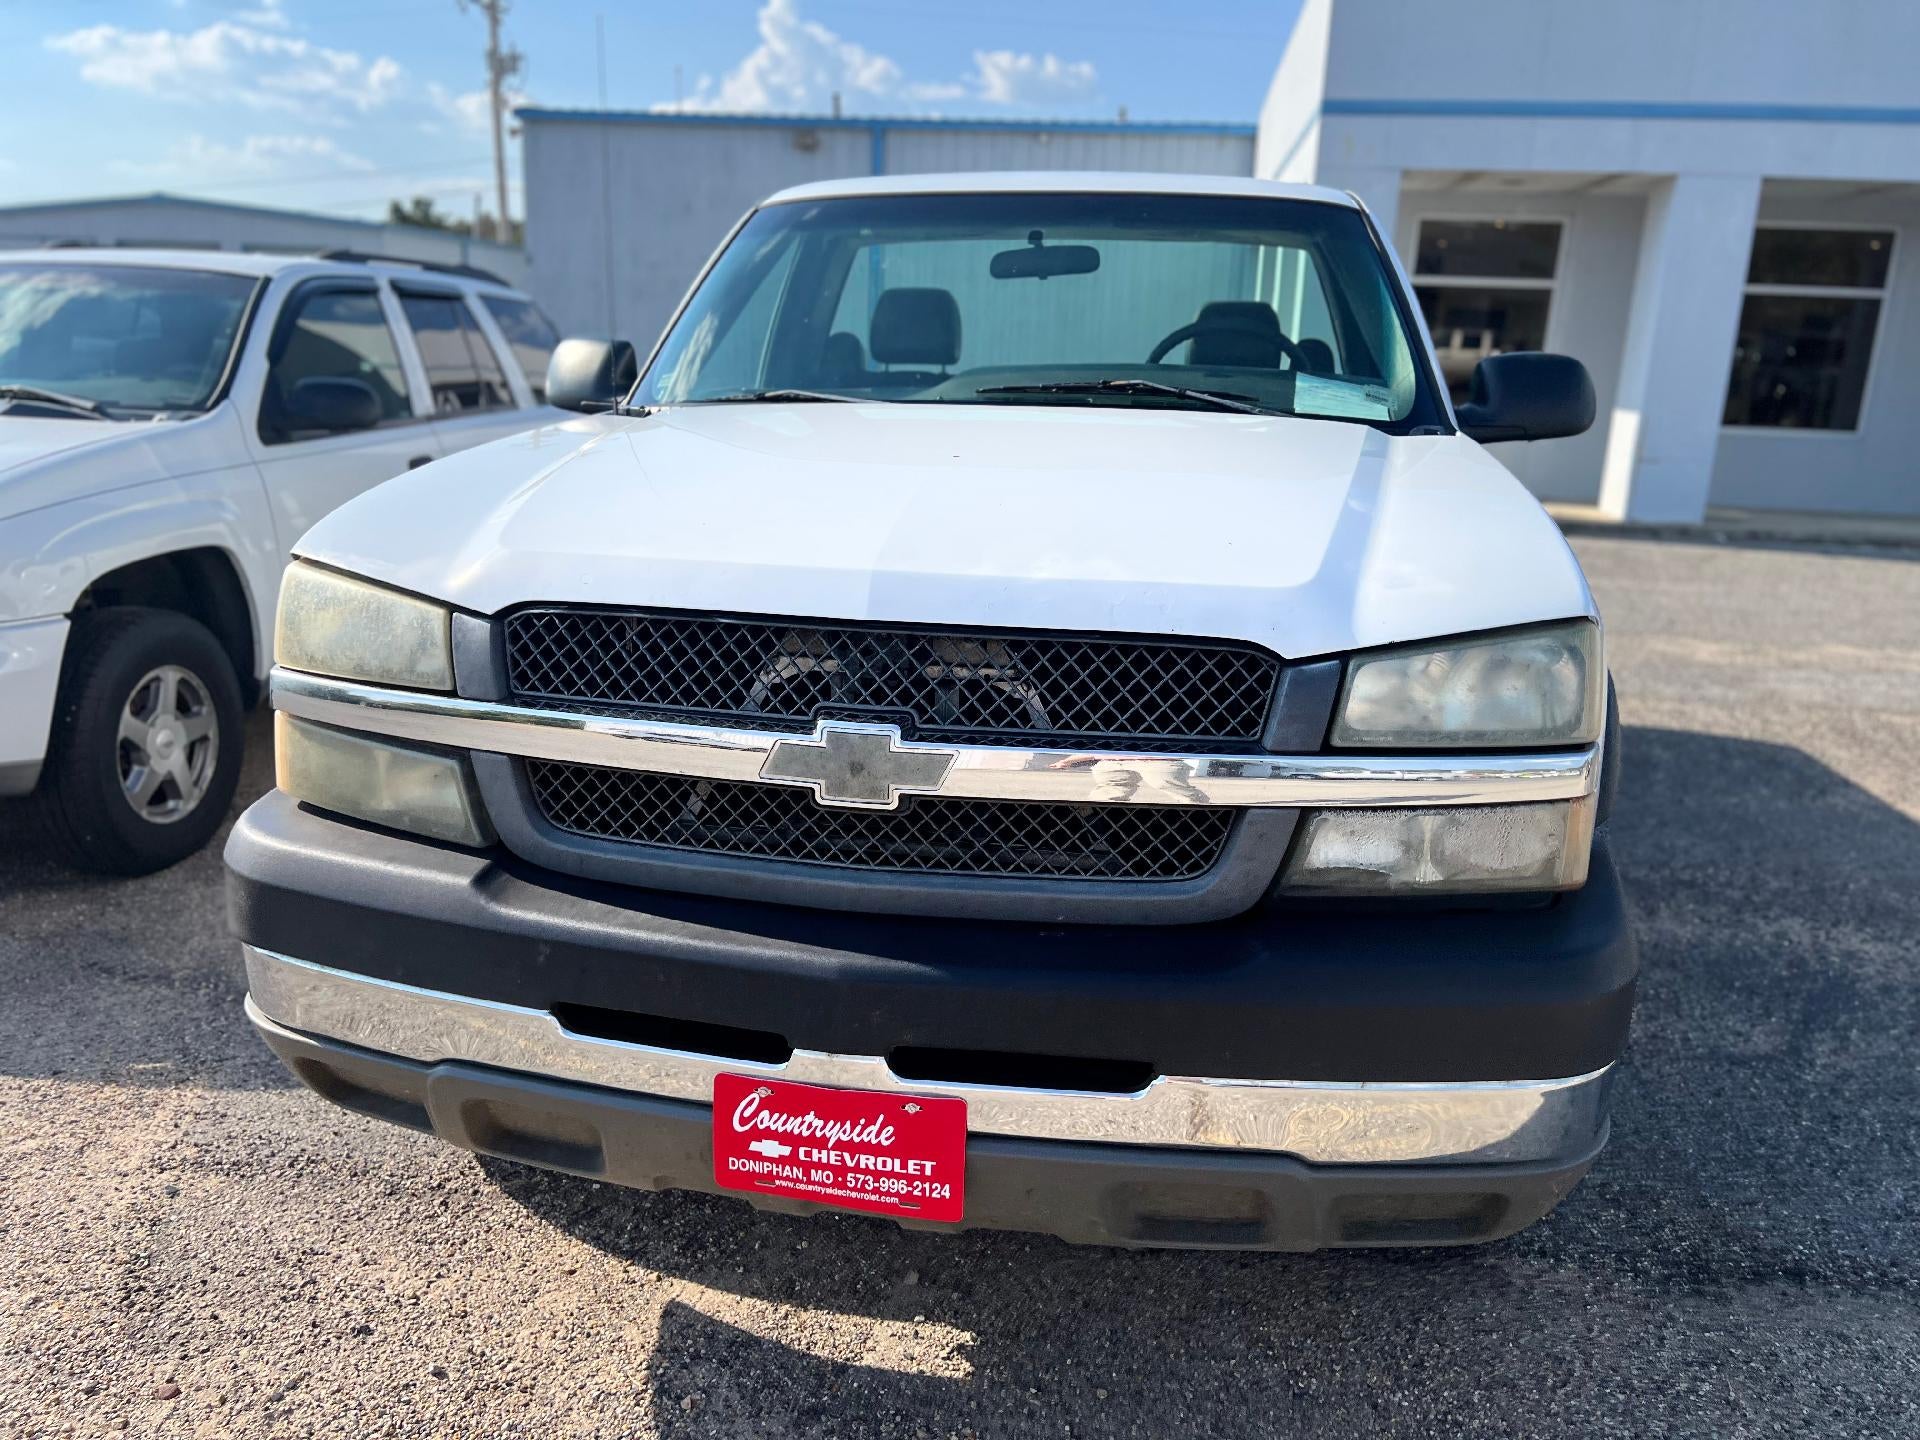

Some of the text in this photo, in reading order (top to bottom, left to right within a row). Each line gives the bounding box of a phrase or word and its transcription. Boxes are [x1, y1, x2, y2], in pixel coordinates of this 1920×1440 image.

[732, 1092, 895, 1148] Countryside
[728, 1157, 950, 1199] DONIPHAN, MO 573-996-2124
[798, 1146, 936, 1176] CHEVROLET
[774, 1178, 899, 1204] www.countrysidechevrolet.com
